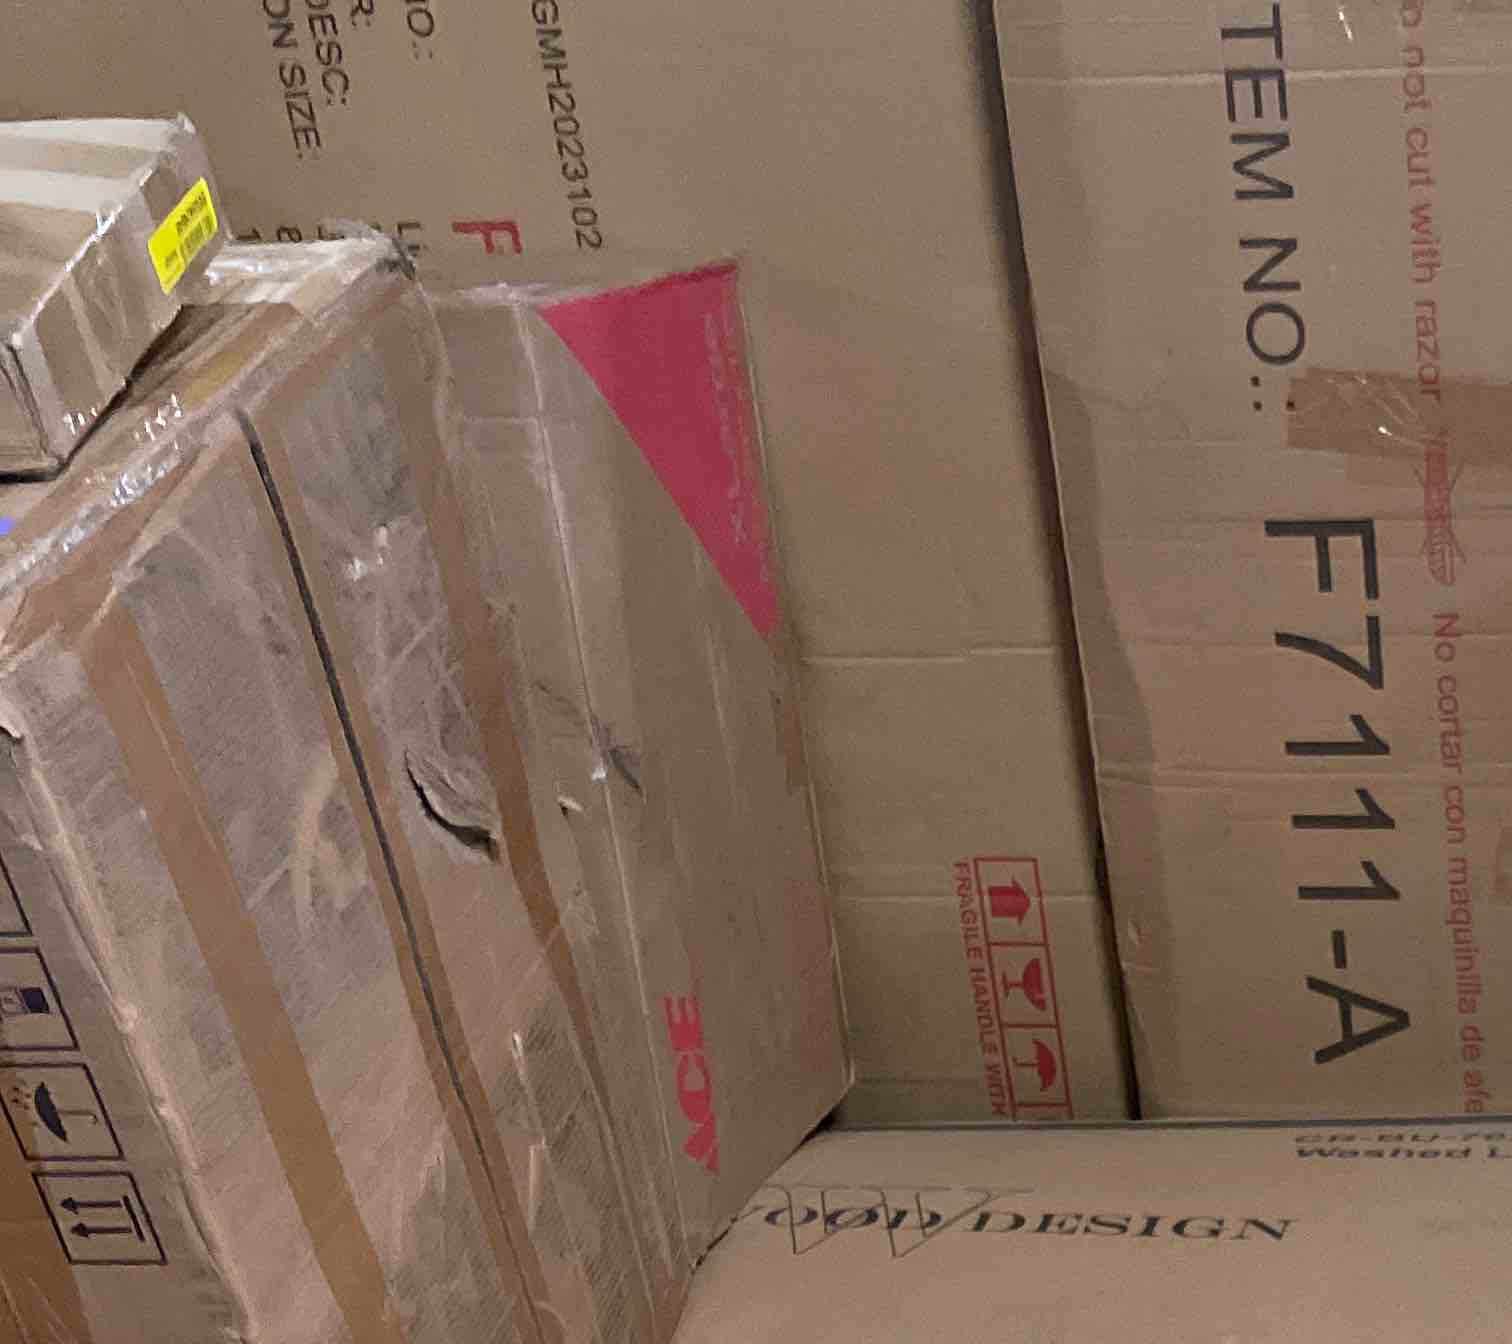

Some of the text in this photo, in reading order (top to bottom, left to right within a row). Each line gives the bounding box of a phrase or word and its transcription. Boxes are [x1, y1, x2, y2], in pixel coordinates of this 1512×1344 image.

[404, 0, 435, 61] O.:
[1405, 127, 1434, 189] cut
[451, 219, 524, 256] F
[1407, 202, 1438, 286] with
[1413, 300, 1442, 402] razor
[1433, 612, 1460, 664] No
[1435, 674, 1464, 776] cortar
[1264, 517, 1412, 1066] F7111-A
[1443, 786, 1468, 844] con
[953, 860, 984, 961] FRAGILE
[971, 964, 999, 1055] HANDLE
[1446, 857, 1485, 1015] maquinilla
[1460, 1023, 1485, 1061] de
[971, 1209, 1289, 1241] DESIGN
